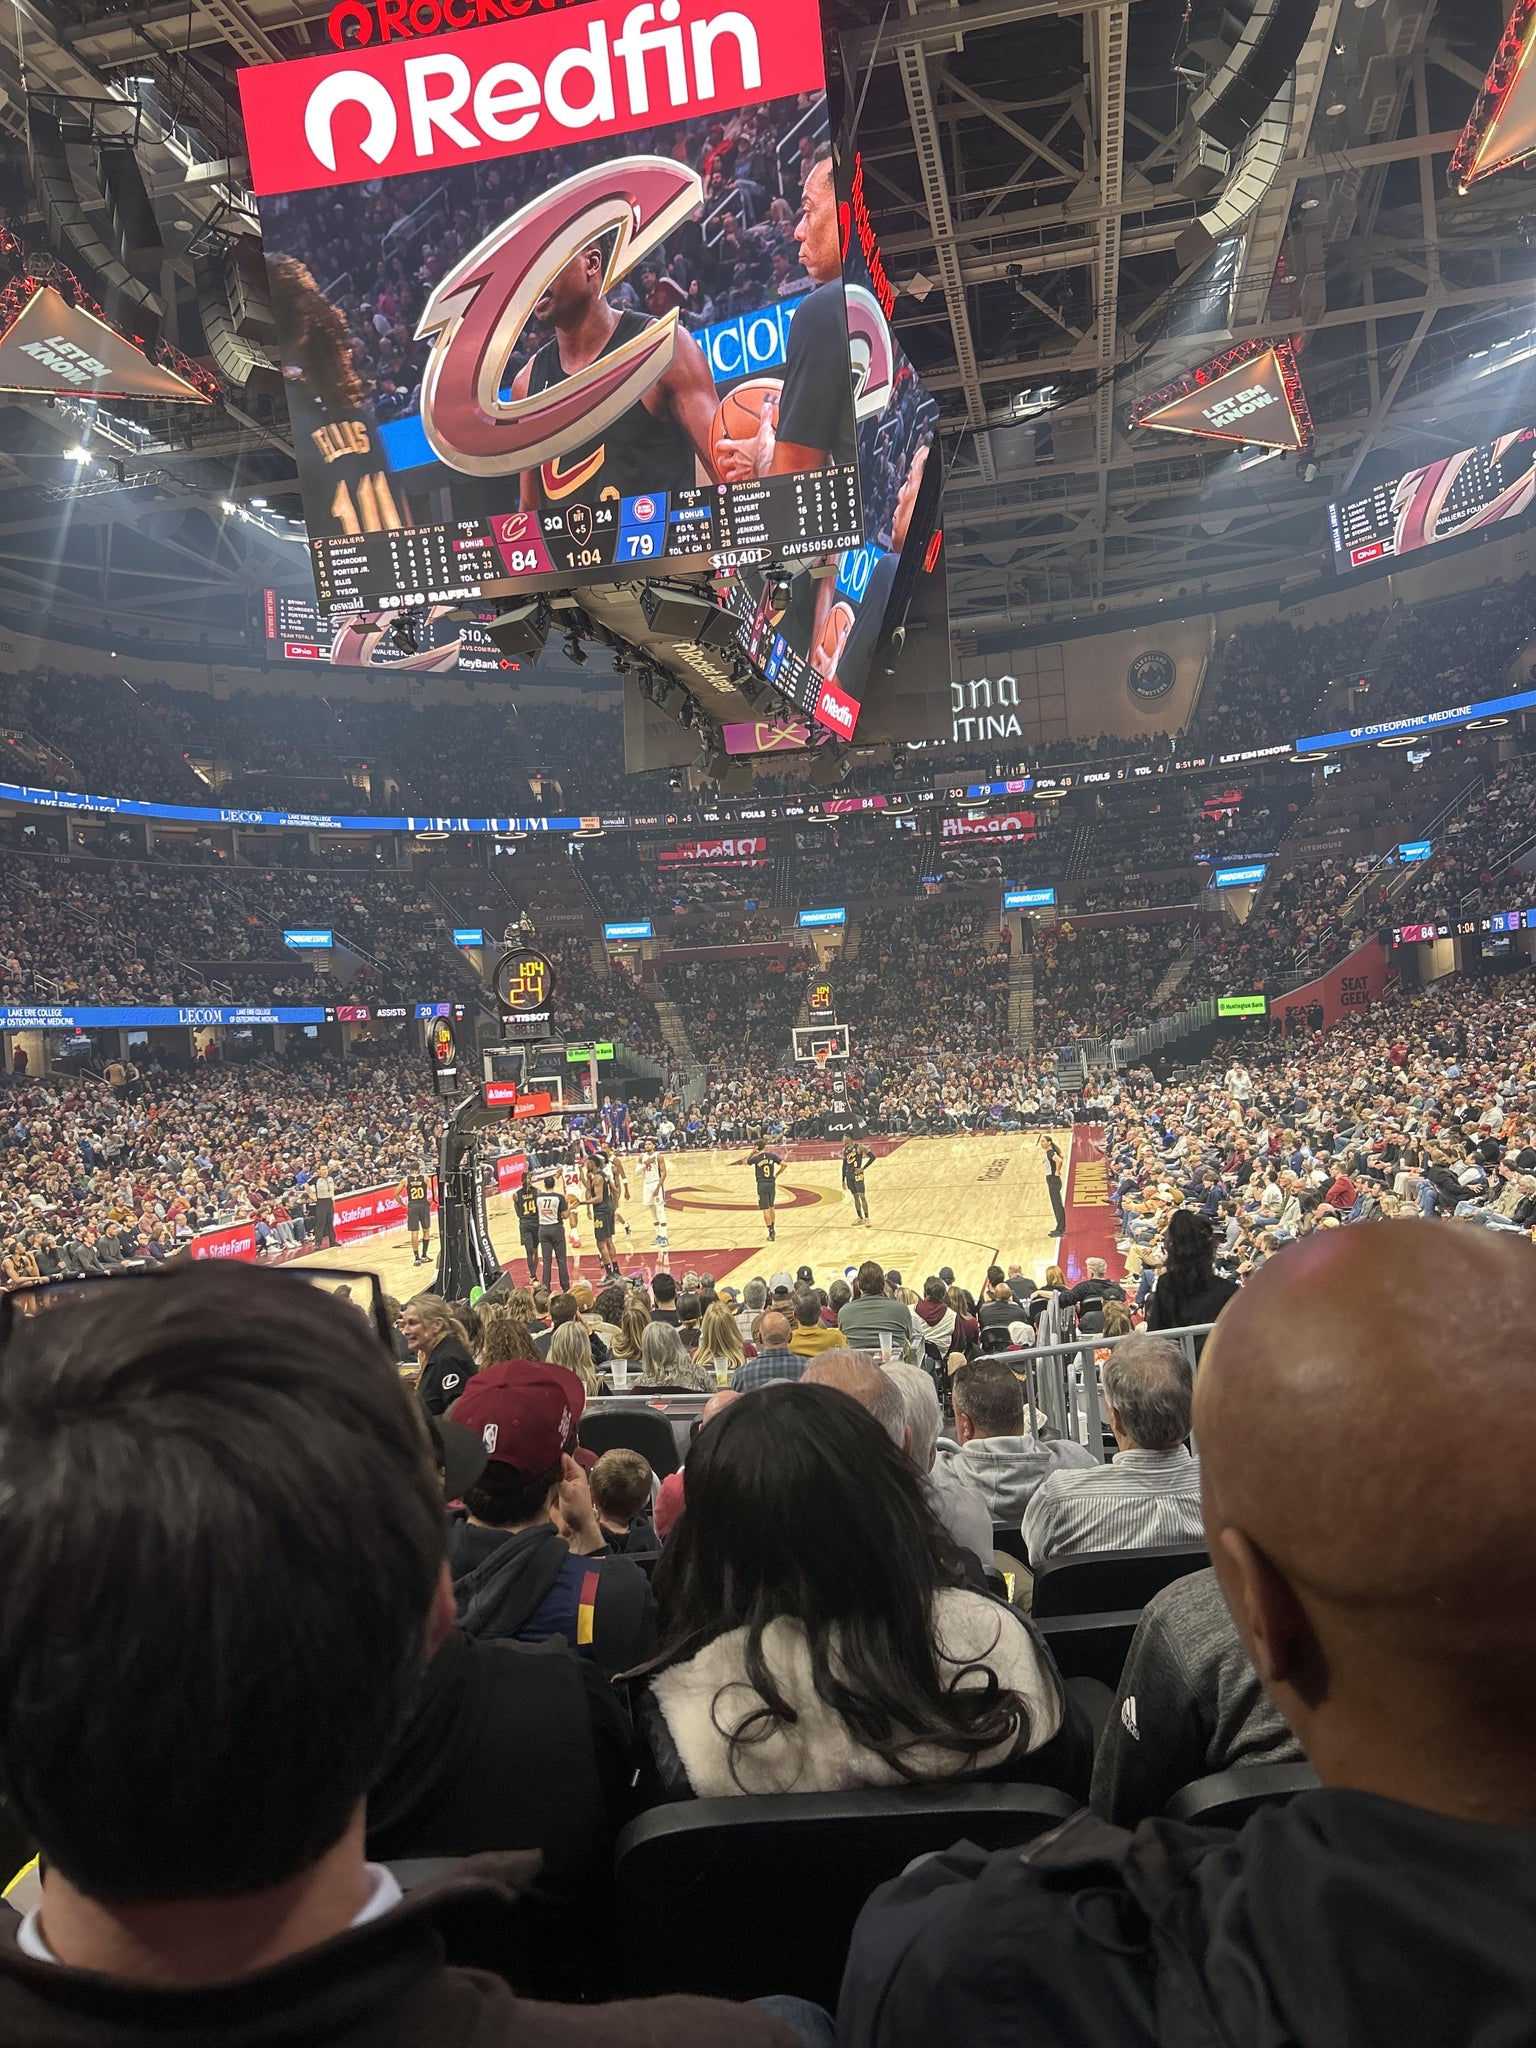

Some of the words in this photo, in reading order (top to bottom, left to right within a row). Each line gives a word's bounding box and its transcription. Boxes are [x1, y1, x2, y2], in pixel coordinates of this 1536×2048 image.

[404, 0, 761, 156] Redfin
[19, 341, 92, 385] KNOW.
[44, 336, 90, 360] LET
[77, 357, 112, 378] EM
[1201, 397, 1236, 419] LET
[1234, 384, 1266, 403] EM
[1210, 393, 1279, 428] KNOW.
[732, 481, 761, 492] PISTONS
[793, 474, 805, 482] PTS
[826, 468, 839, 477] AST
[843, 466, 855, 474] FLS
[679, 490, 701, 499] FOULS
[732, 492, 764, 503] HOLLAND
[688, 498, 695, 507] 5
[733, 503, 760, 514] LEVERT
[596, 509, 612, 523] 24
[679, 510, 704, 520] BONUS
[719, 518, 729, 526] 12
[735, 514, 761, 524] HARRIS
[458, 520, 479, 530] FOULS
[544, 516, 563, 531] 3Q
[575, 525, 587, 534] +5
[700, 522, 709, 530] 48
[329, 536, 365, 546] CAVALIERS
[419, 527, 431, 535] AST
[434, 525, 445, 533] FLS
[466, 528, 473, 537] 5
[720, 528, 731, 537] 24
[736, 523, 765, 535] JENKINS
[700, 532, 711, 541] 44
[737, 534, 770, 546] STEWART
[460, 539, 484, 549] BONUS
[626, 534, 654, 557] 79
[782, 534, 861, 556] CAVS5050.COM
[330, 547, 357, 557] BRYANT
[482, 551, 492, 559] 44
[511, 549, 538, 572] 84
[566, 549, 602, 568] 1:04
[711, 549, 764, 569] $10,401
[333, 567, 359, 576] PORTER
[459, 563, 471, 571] 3PT
[483, 561, 493, 569] 33
[320, 580, 329, 588] 14
[334, 578, 352, 586] ELLIS
[461, 574, 474, 582] TOL
[484, 572, 495, 580] CH
[321, 590, 331, 598] 20
[336, 587, 359, 596] TYSON
[396, 581, 405, 589] 15
[428, 587, 482, 603] RAFFLE
[330, 597, 364, 612] oswald
[458, 628, 492, 643] $10,4
[459, 658, 499, 670] KeyBank
[829, 697, 853, 728] Redfin
[1350, 728, 1364, 738] OF
[1365, 716, 1427, 735] OSTEOPATHIC
[1428, 705, 1472, 723] MEDICINE
[1220, 754, 1241, 763] LET
[1241, 751, 1257, 760] EM
[1060, 777, 1072, 786] 48
[1084, 773, 1110, 783] FOULS
[1135, 767, 1152, 776] TOL
[1175, 761, 1191, 770] 8:51
[1193, 759, 1205, 767] PM
[918, 793, 934, 801] 1:04
[949, 789, 963, 798] 3Q
[979, 786, 990, 795] 79
[862, 799, 873, 808] 84
[704, 813, 720, 822] TOL
[741, 810, 766, 819] FOULS
[809, 805, 819, 814] 44
[1300, 842, 1342, 852] LITEHOUSE
[1218, 869, 1264, 881] PROGRESSIVE
[1006, 893, 1052, 904] PROGRESSIVE
[801, 912, 843, 922] PROGRESSIVE
[1457, 922, 1475, 934] 1:04
[1481, 920, 1491, 930] 24
[1493, 918, 1504, 929] 79
[606, 926, 650, 935] PROGRESSIVE
[1421, 927, 1434, 938] 84
[520, 962, 544, 976] 1:04
[1341, 976, 1368, 991] SEAT
[509, 976, 543, 1004] 24
[812, 994, 829, 1008] 24
[1341, 991, 1370, 1006] GEEK
[8, 1009, 24, 1017] LAKE
[24, 1009, 37, 1017] ERIE
[38, 1009, 62, 1017] COLLEGE
[179, 1009, 223, 1023] LECOM
[356, 1009, 367, 1019] 23
[377, 1008, 406, 1017] ASSISTS
[421, 1007, 431, 1016] 20
[516, 1012, 550, 1022] TISSOT
[7, 1018, 46, 1026] OSTEOPATHIC
[763, 1165, 770, 1178] 9
[565, 1174, 579, 1185] 24
[410, 1187, 424, 1200] 20
[522, 1200, 536, 1215] 14
[543, 1199, 552, 1208] 77
[476, 1185, 486, 1237] Cleveland
[482, 1238, 496, 1268] Clinic
